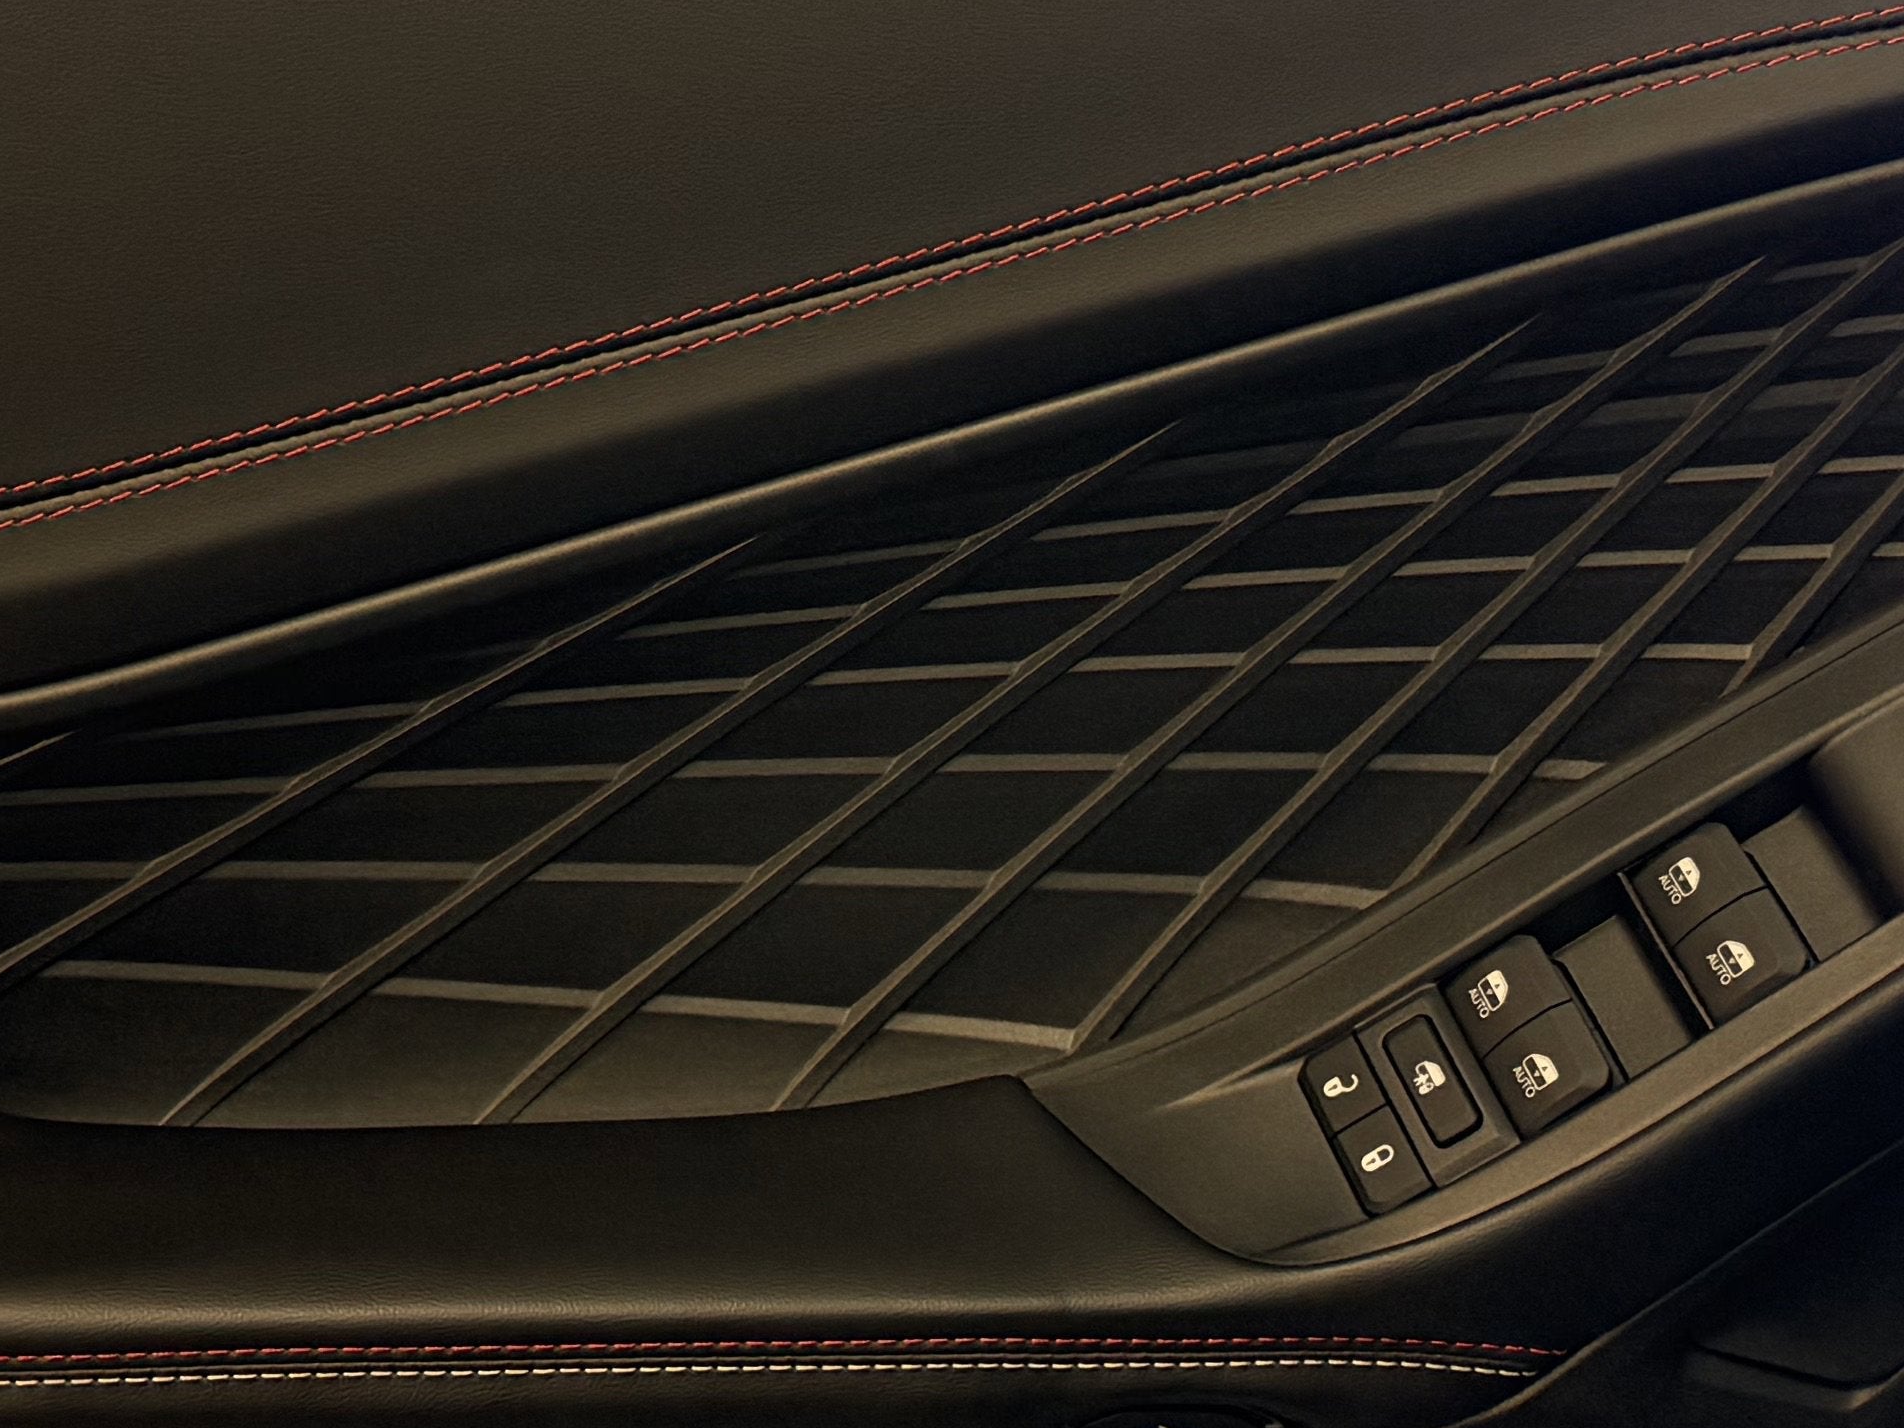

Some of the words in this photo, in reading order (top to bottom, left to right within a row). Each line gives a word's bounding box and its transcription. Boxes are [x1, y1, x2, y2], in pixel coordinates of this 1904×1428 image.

[1658, 874, 1682, 905] AUTO
[1706, 953, 1731, 985] AUTO
[1468, 988, 1489, 1019] AUTO
[1513, 1066, 1535, 1098] AUTO
